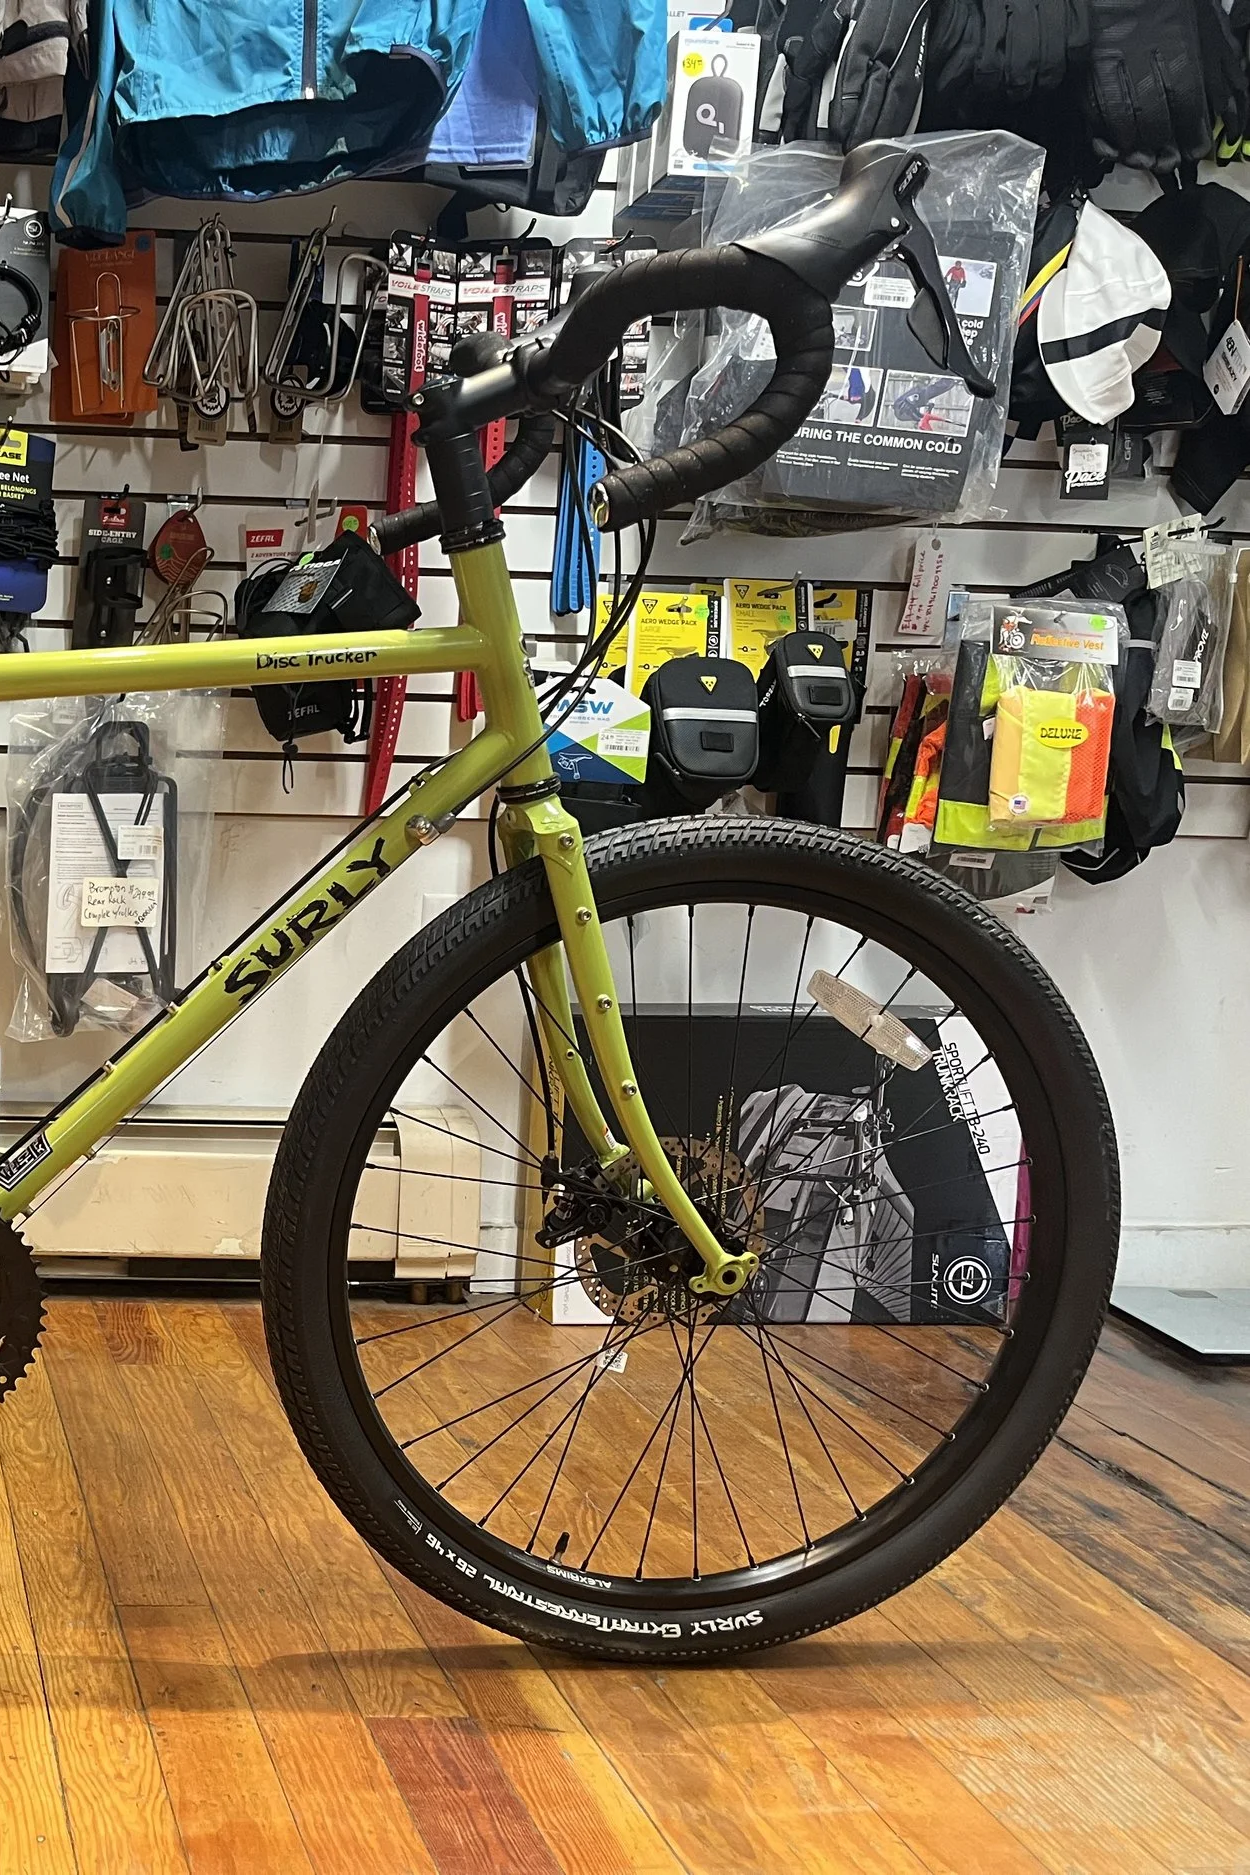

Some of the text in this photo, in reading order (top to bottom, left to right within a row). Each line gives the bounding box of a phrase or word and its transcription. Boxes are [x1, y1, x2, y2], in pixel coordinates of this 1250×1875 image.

[420, 285, 454, 297] STRAPS
[502, 284, 546, 293] STRAPS
[962, 318, 984, 329] cold
[415, 320, 427, 373] widefoot
[1060, 413, 1083, 431] Pac
[836, 430, 861, 445] THE
[864, 434, 923, 451] COMMON
[925, 440, 962, 455] COLD
[12, 471, 30, 484] Net
[1064, 470, 1107, 494] Pace
[1, 484, 37, 495] BELONGINGS
[3, 491, 25, 500] BASKET
[88, 529, 138, 538] SIDE-ENTRY
[250, 535, 275, 543] ZEFAL
[735, 602, 749, 610] AERO
[750, 602, 770, 611] WEDGE
[640, 618, 660, 626] AERO
[1031, 633, 1104, 651] Reflective Vest
[257, 649, 378, 671] Disc Trucker
[1040, 727, 1083, 740] DELUXE
[89, 881, 126, 895] Brompton
[88, 895, 126, 905] Rear Rack
[224, 837, 391, 1007] SURLY
[932, 1046, 965, 1122] TRUNK RACK
[944, 1042, 966, 1082] SPORT
[967, 1108, 990, 1155] TB-240
[424, 1532, 446, 1551] 46
[455, 1555, 478, 1579] 26
[546, 1564, 613, 1590] ALEXRIMS
